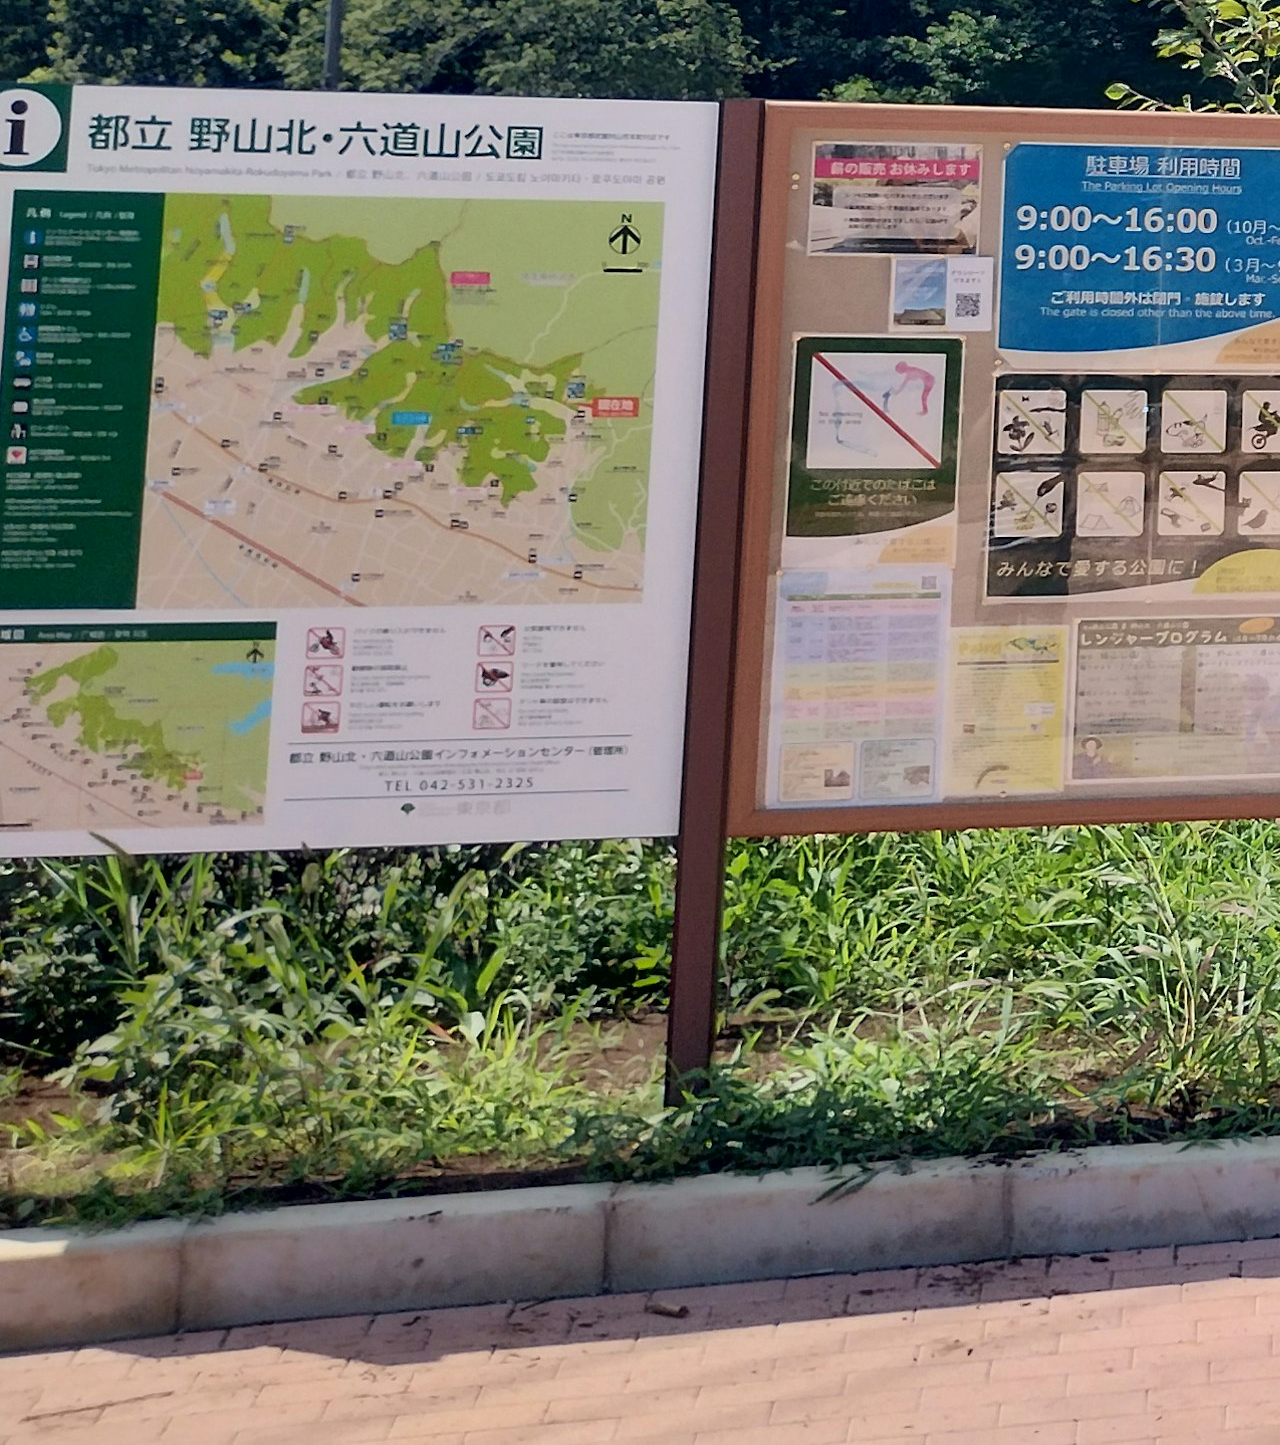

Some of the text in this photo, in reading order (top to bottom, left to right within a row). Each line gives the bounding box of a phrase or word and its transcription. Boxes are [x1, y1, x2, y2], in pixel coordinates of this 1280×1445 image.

[88, 114, 172, 151] 都立
[189, 116, 544, 161] 野山北・六道山公園
[312, 169, 332, 178] Park
[830, 161, 972, 176] 薪の販売 お休みします
[1085, 156, 1241, 178] 駐車場 利用時間
[1082, 181, 1242, 194] The Parking Lot Opening Hours
[621, 213, 632, 223] N
[1016, 205, 1218, 234] 9:00～16:00
[1014, 244, 1217, 272] 9:00～16:30
[1040, 306, 1276, 319] The gate is closed other than the above time.
[810, 479, 937, 492] この付近でのたばこは
[828, 493, 918, 506] ご遠慮ください
[1080, 629, 1228, 646] レンジャープログラム
[289, 752, 314, 764] 都立
[384, 777, 535, 791] TEL 042-531-2325
